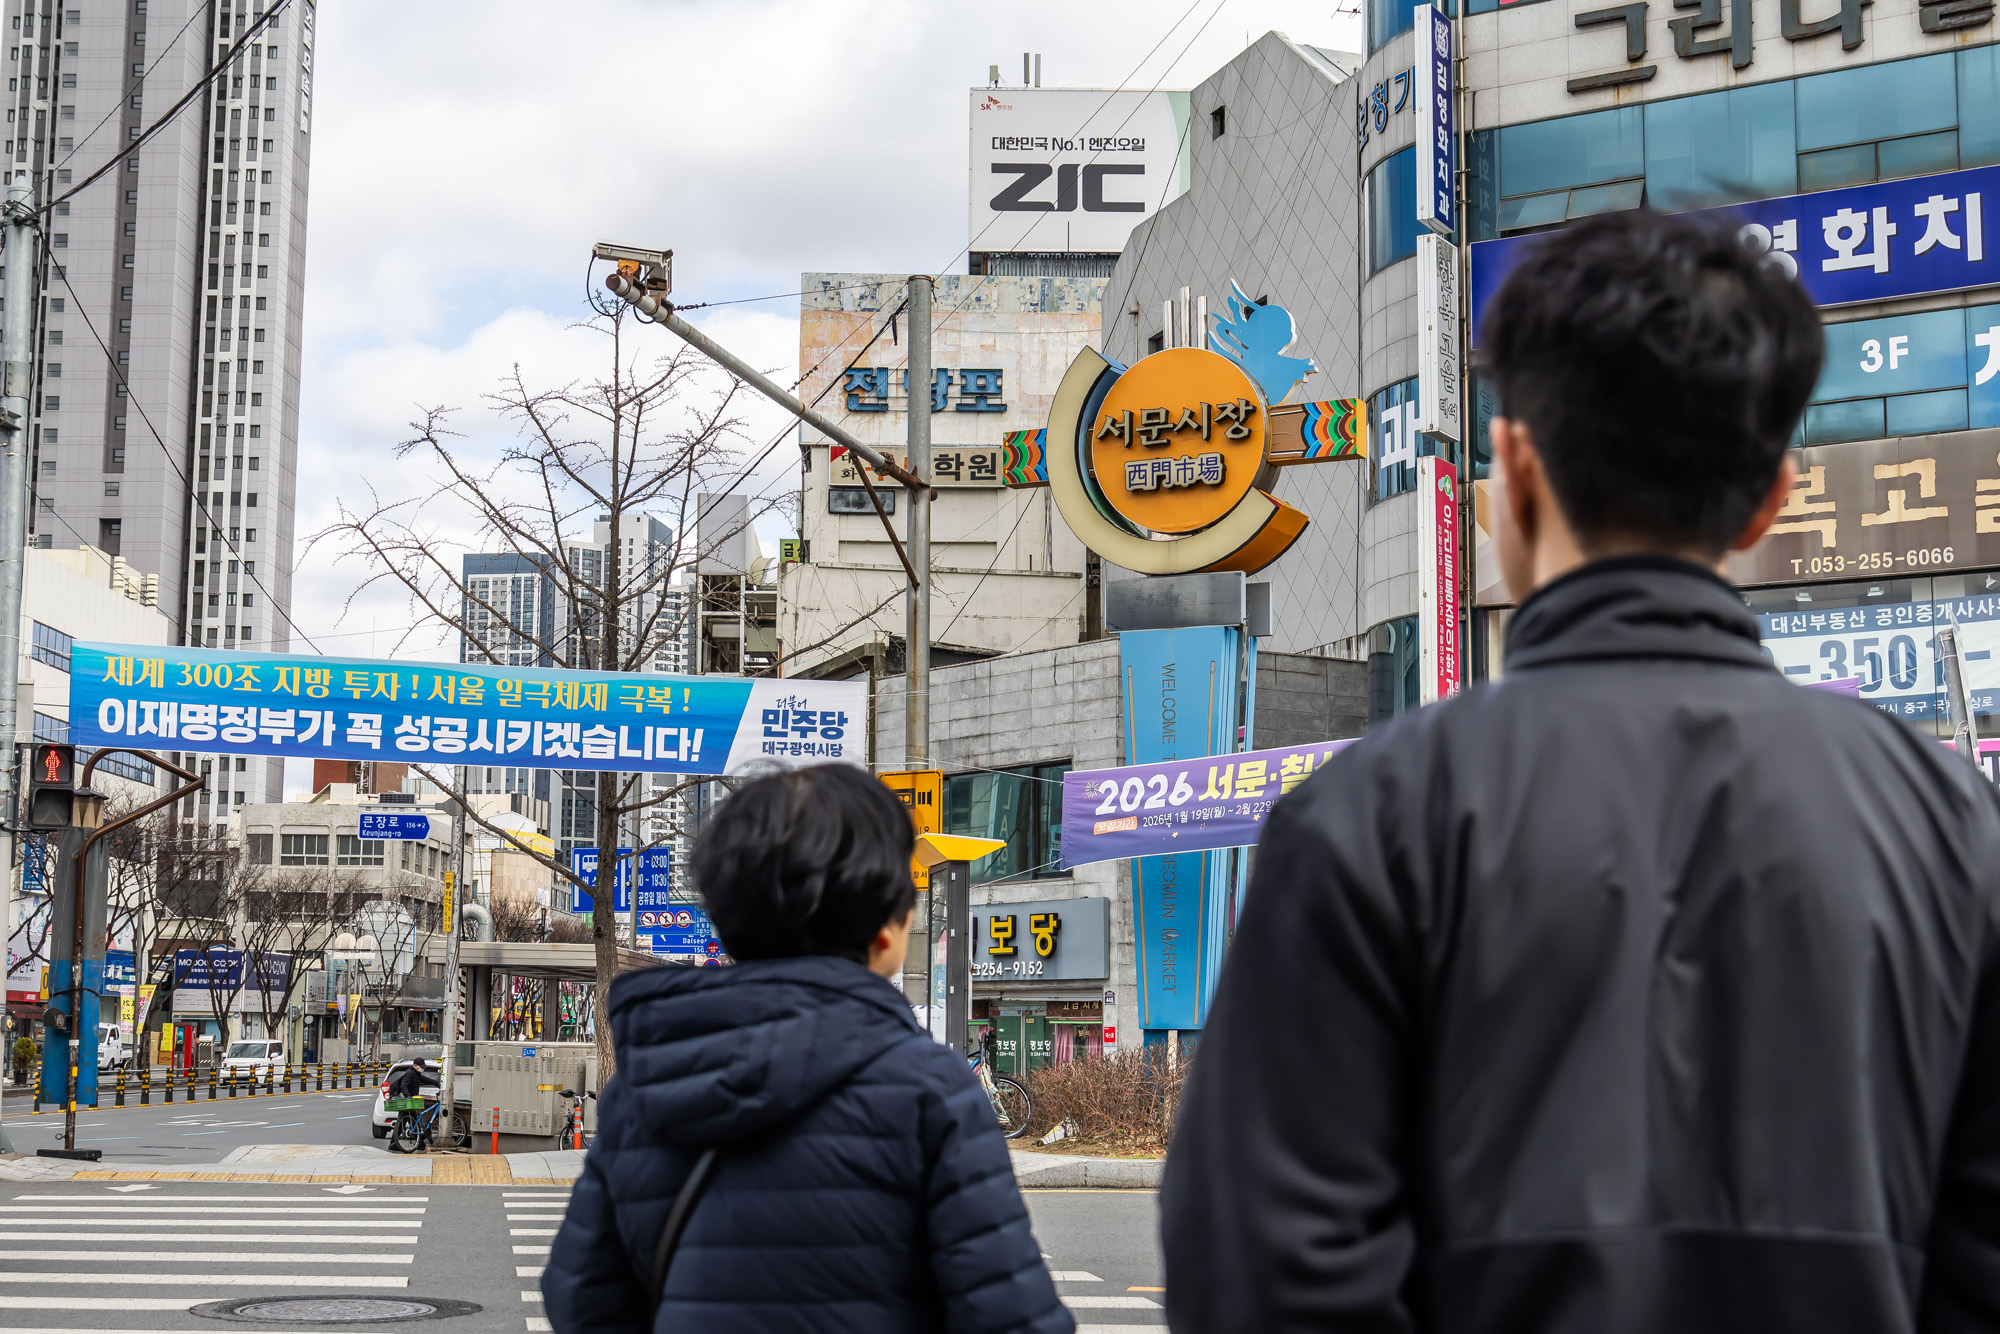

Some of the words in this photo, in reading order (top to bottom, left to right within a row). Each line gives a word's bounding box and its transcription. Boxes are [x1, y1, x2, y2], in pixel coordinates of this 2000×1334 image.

[992, 136, 1048, 151] 대한민국
[1052, 137, 1084, 151] No.1
[1089, 137, 1145, 151] 엔진오일
[1436, 61, 1449, 221] 김영화치과
[989, 162, 1146, 212] ZIC
[1860, 335, 1909, 373] 3F
[1095, 398, 1256, 449] 서문시장
[934, 452, 997, 481] 학원
[1127, 455, 1221, 491] 西門市場
[1791, 547, 1954, 575] T.053-255-6066
[1771, 611, 1866, 634] 대신부동산
[1875, 598, 2000, 626] 공인중개사사
[102, 656, 165, 689] 재계
[177, 662, 262, 692] 300조
[272, 666, 333, 698] 지방
[343, 670, 401, 701] 투자
[427, 675, 485, 706] 서울
[496, 680, 609, 712] 일극체제
[618, 684, 673, 715] 극복
[776, 695, 807, 711] 더불어
[1162, 662, 1176, 745] WELCOME
[762, 709, 848, 740] 민주당
[1904, 701, 1927, 714] 중구
[98, 697, 337, 747] 이재명정부가
[347, 712, 383, 750] 꼭
[393, 715, 704, 762] 성공시키겠습니다!
[762, 741, 843, 758] 대구광역시당
[1095, 771, 1193, 815] 2026
[362, 829, 401, 838] Keunjang-ro
[363, 816, 399, 829] 큰장로
[1097, 818, 1135, 832] 모집기간
[1143, 814, 1173, 828] 2026년
[1174, 811, 1188, 824] 1월
[1191, 806, 1225, 822] 19일(월)
[1235, 803, 1250, 815] 2월
[1162, 852, 1176, 919] SEOMUN
[973, 913, 1062, 958] 보당
[982, 960, 1043, 976] 254-9152
[1162, 928, 1176, 996] MARKET
